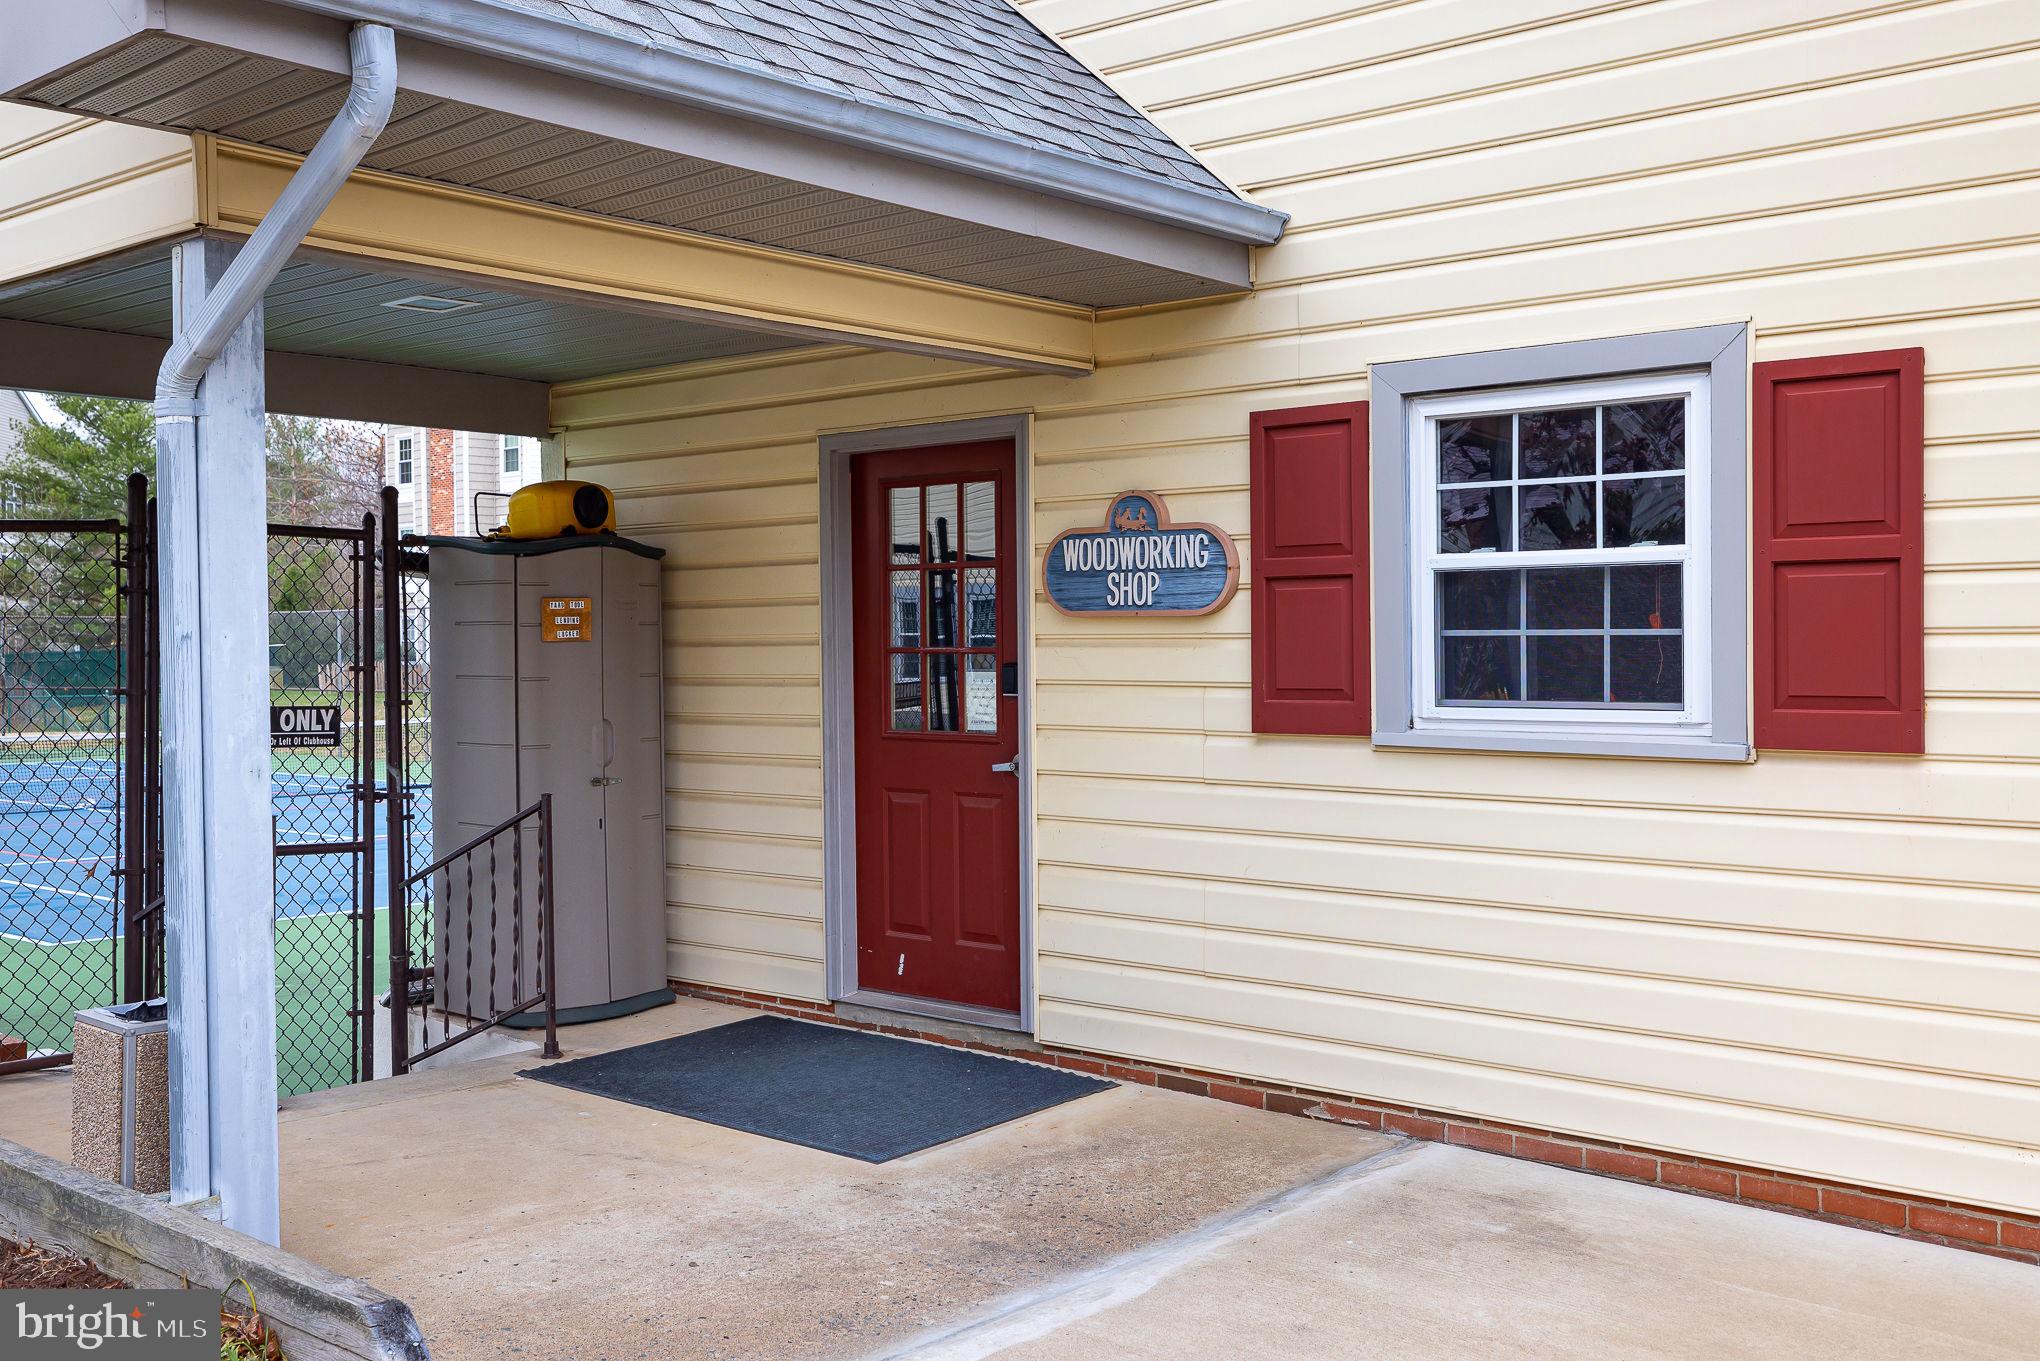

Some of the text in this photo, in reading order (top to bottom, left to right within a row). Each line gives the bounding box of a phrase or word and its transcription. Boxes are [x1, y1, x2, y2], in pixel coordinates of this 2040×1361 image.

[1063, 533, 1210, 572] WOODWORKING
[1106, 571, 1160, 607] SHOP
[558, 630, 579, 638] LOCKER
[280, 709, 335, 731] ONLY
[279, 737, 292, 746] Left
[293, 737, 301, 745] Of
[303, 737, 334, 745] Clubhouse
